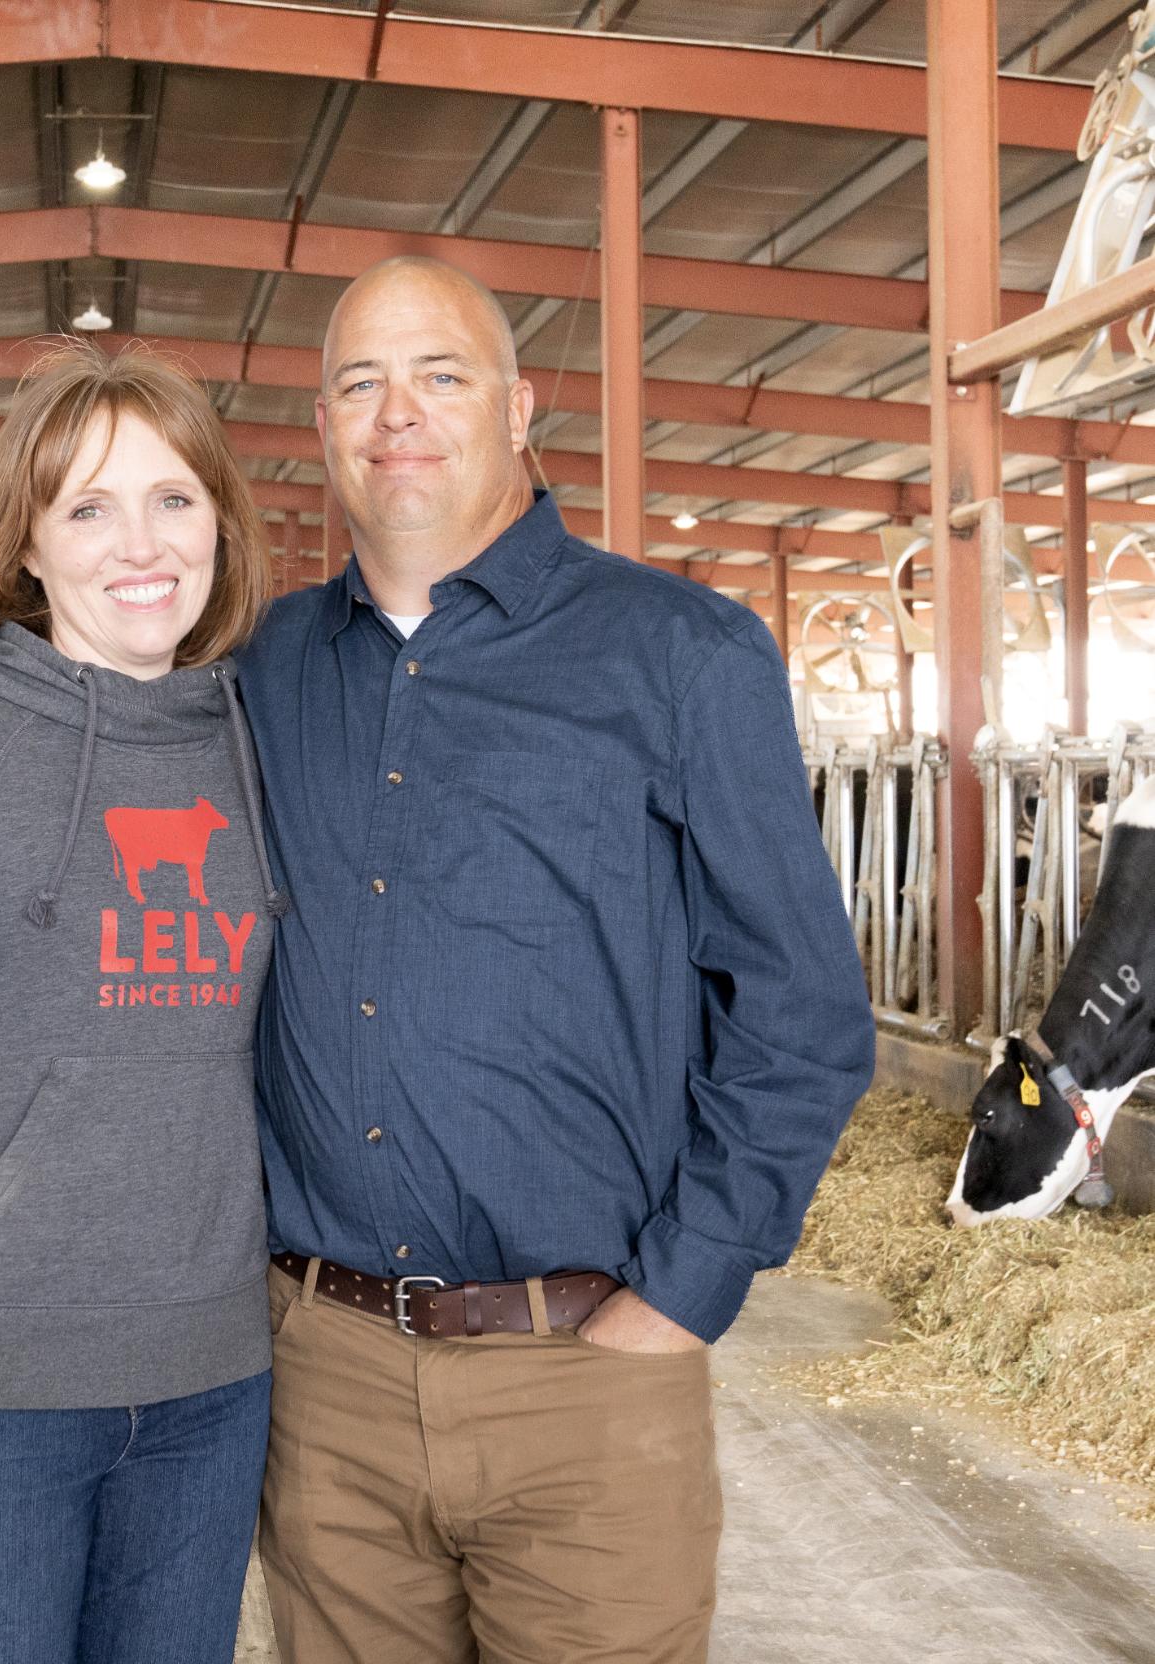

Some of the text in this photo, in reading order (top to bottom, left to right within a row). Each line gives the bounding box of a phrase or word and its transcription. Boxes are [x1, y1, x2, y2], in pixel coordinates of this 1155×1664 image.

[99, 908, 258, 974] LELY
[98, 982, 242, 1008] SINCE 1948
[1079, 964, 1141, 1025] 718
